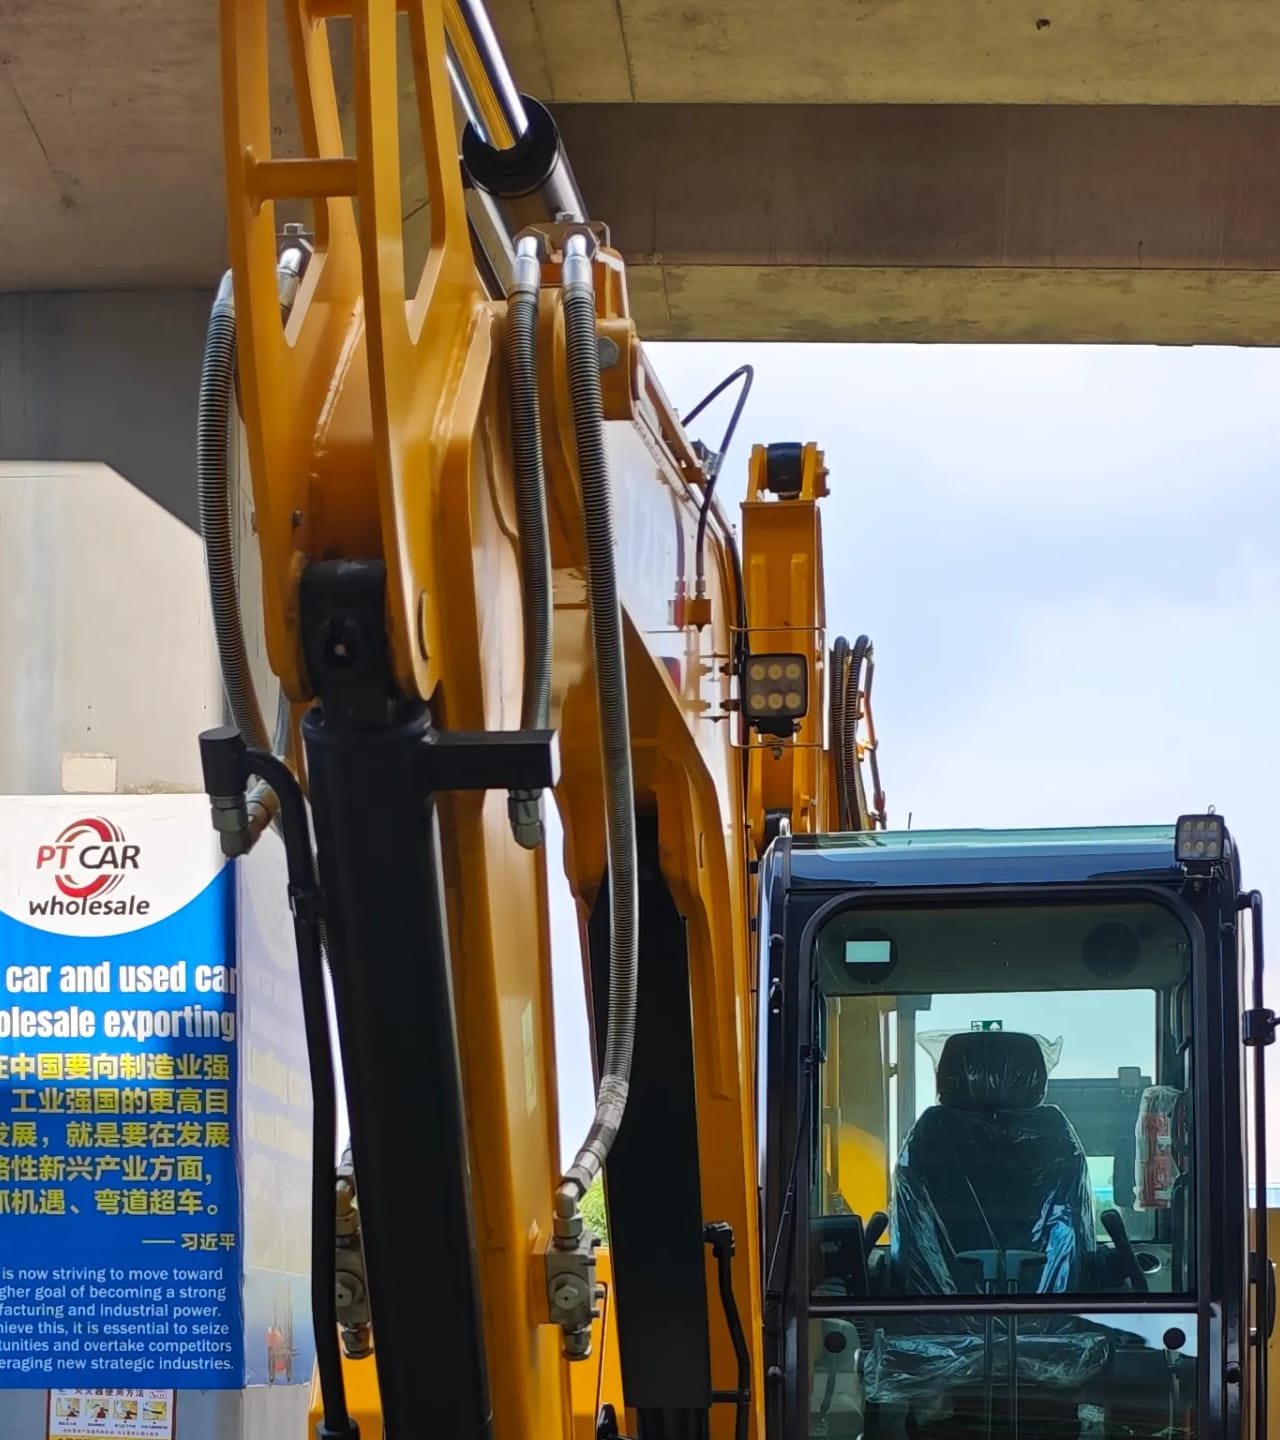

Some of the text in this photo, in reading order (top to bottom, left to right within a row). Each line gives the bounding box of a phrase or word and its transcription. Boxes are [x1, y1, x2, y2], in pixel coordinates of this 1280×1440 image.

[36, 845, 141, 869] PT CAR
[29, 895, 151, 915] wholesale
[6, 965, 52, 993] car
[60, 961, 111, 993] and
[119, 961, 186, 993] used
[195, 965, 238, 994] car
[104, 1004, 235, 1042] exporting
[2, 1267, 14, 1280] is
[18, 1269, 48, 1280] now
[52, 1267, 106, 1283] striving
[110, 1267, 124, 1280] to
[128, 1269, 169, 1280] move
[173, 1267, 223, 1280] toward
[35, 1285, 66, 1301] goal
[70, 1285, 85, 1298] of
[89, 1285, 162, 1301] becoming
[166, 1288, 175, 1298] a
[179, 1286, 226, 1301] strong
[68, 1303, 95, 1316] and
[173, 1306, 221, 1319] power.
[38, 1321, 69, 1336] this,
[73, 1321, 82, 1334] it
[87, 1321, 99, 1334] is
[103, 1321, 169, 1334] essential
[173, 1322, 187, 1334] to
[191, 1322, 229, 1334] seize
[53, 1339, 79, 1351] and
[84, 1339, 144, 1352] overtake
[149, 1339, 232, 1354] competitors
[57, 1359, 87, 1369] new
[91, 1357, 154, 1372] strategic
[159, 1357, 234, 1370] industries.
